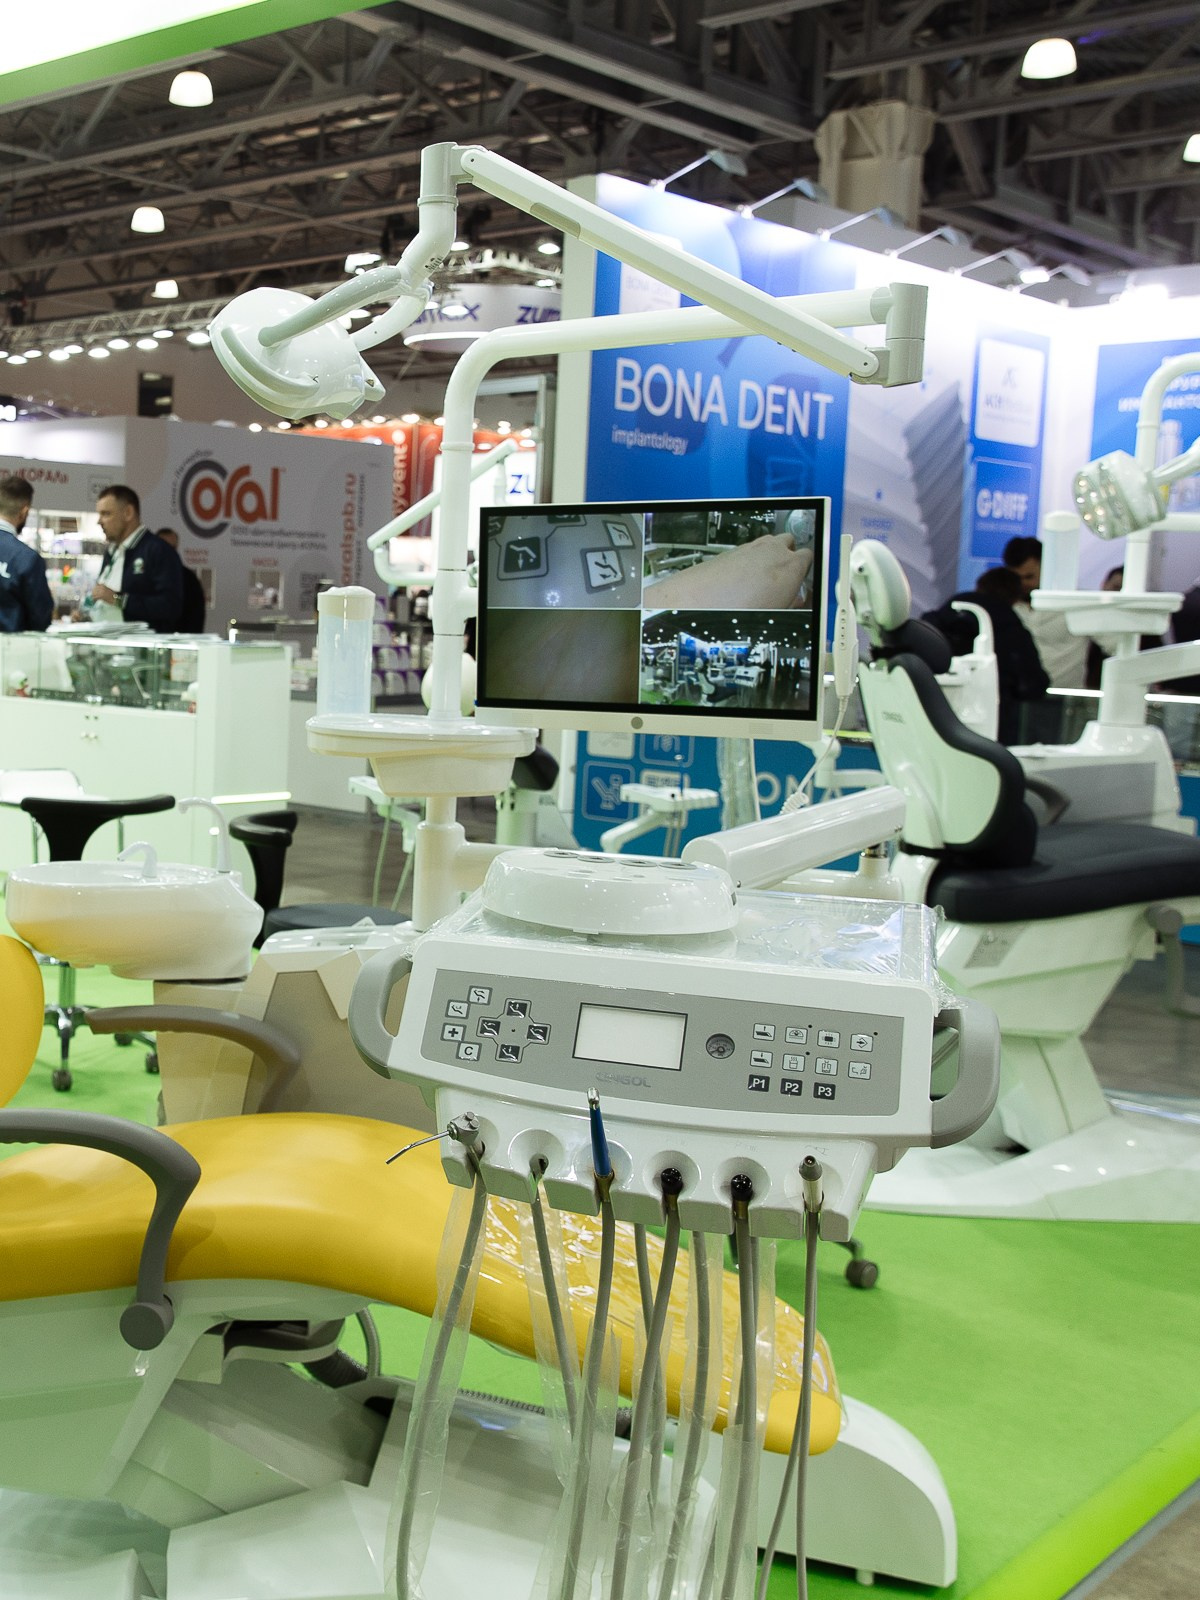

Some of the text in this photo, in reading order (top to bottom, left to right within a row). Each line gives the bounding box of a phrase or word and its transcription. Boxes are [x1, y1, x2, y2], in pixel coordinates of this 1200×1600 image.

[614, 357, 834, 441] BONA DENT
[612, 424, 689, 456] implantology
[341, 473, 356, 587] oralspb.ru
[464, 1045, 474, 1057] C
[752, 1077, 832, 1098] P1 P2 P3
